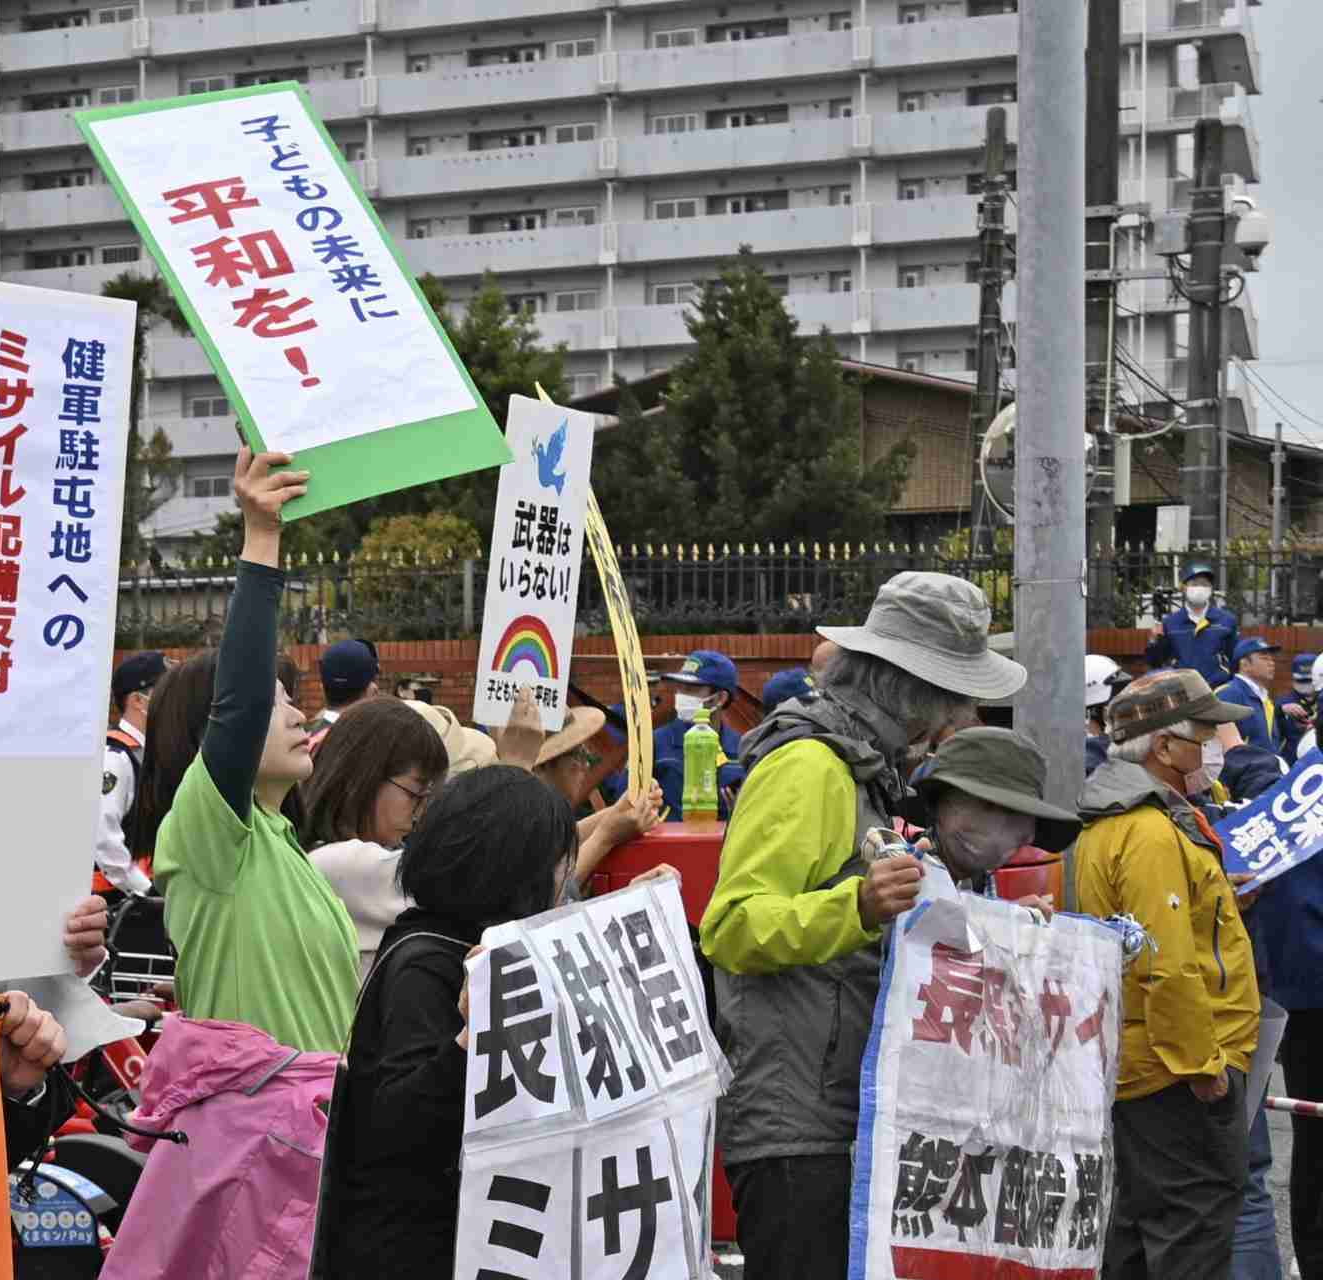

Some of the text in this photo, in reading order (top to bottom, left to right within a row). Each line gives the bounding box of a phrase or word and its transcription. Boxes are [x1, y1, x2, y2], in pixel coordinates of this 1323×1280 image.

[162, 177, 321, 388] 平和を！
[241, 114, 398, 323] 子どもの未来に
[43, 337, 106, 650] 健軍駐屯地への
[499, 557, 571, 603] いらない！
[512, 501, 572, 556] 武器は
[475, 908, 703, 1120] 長射程
